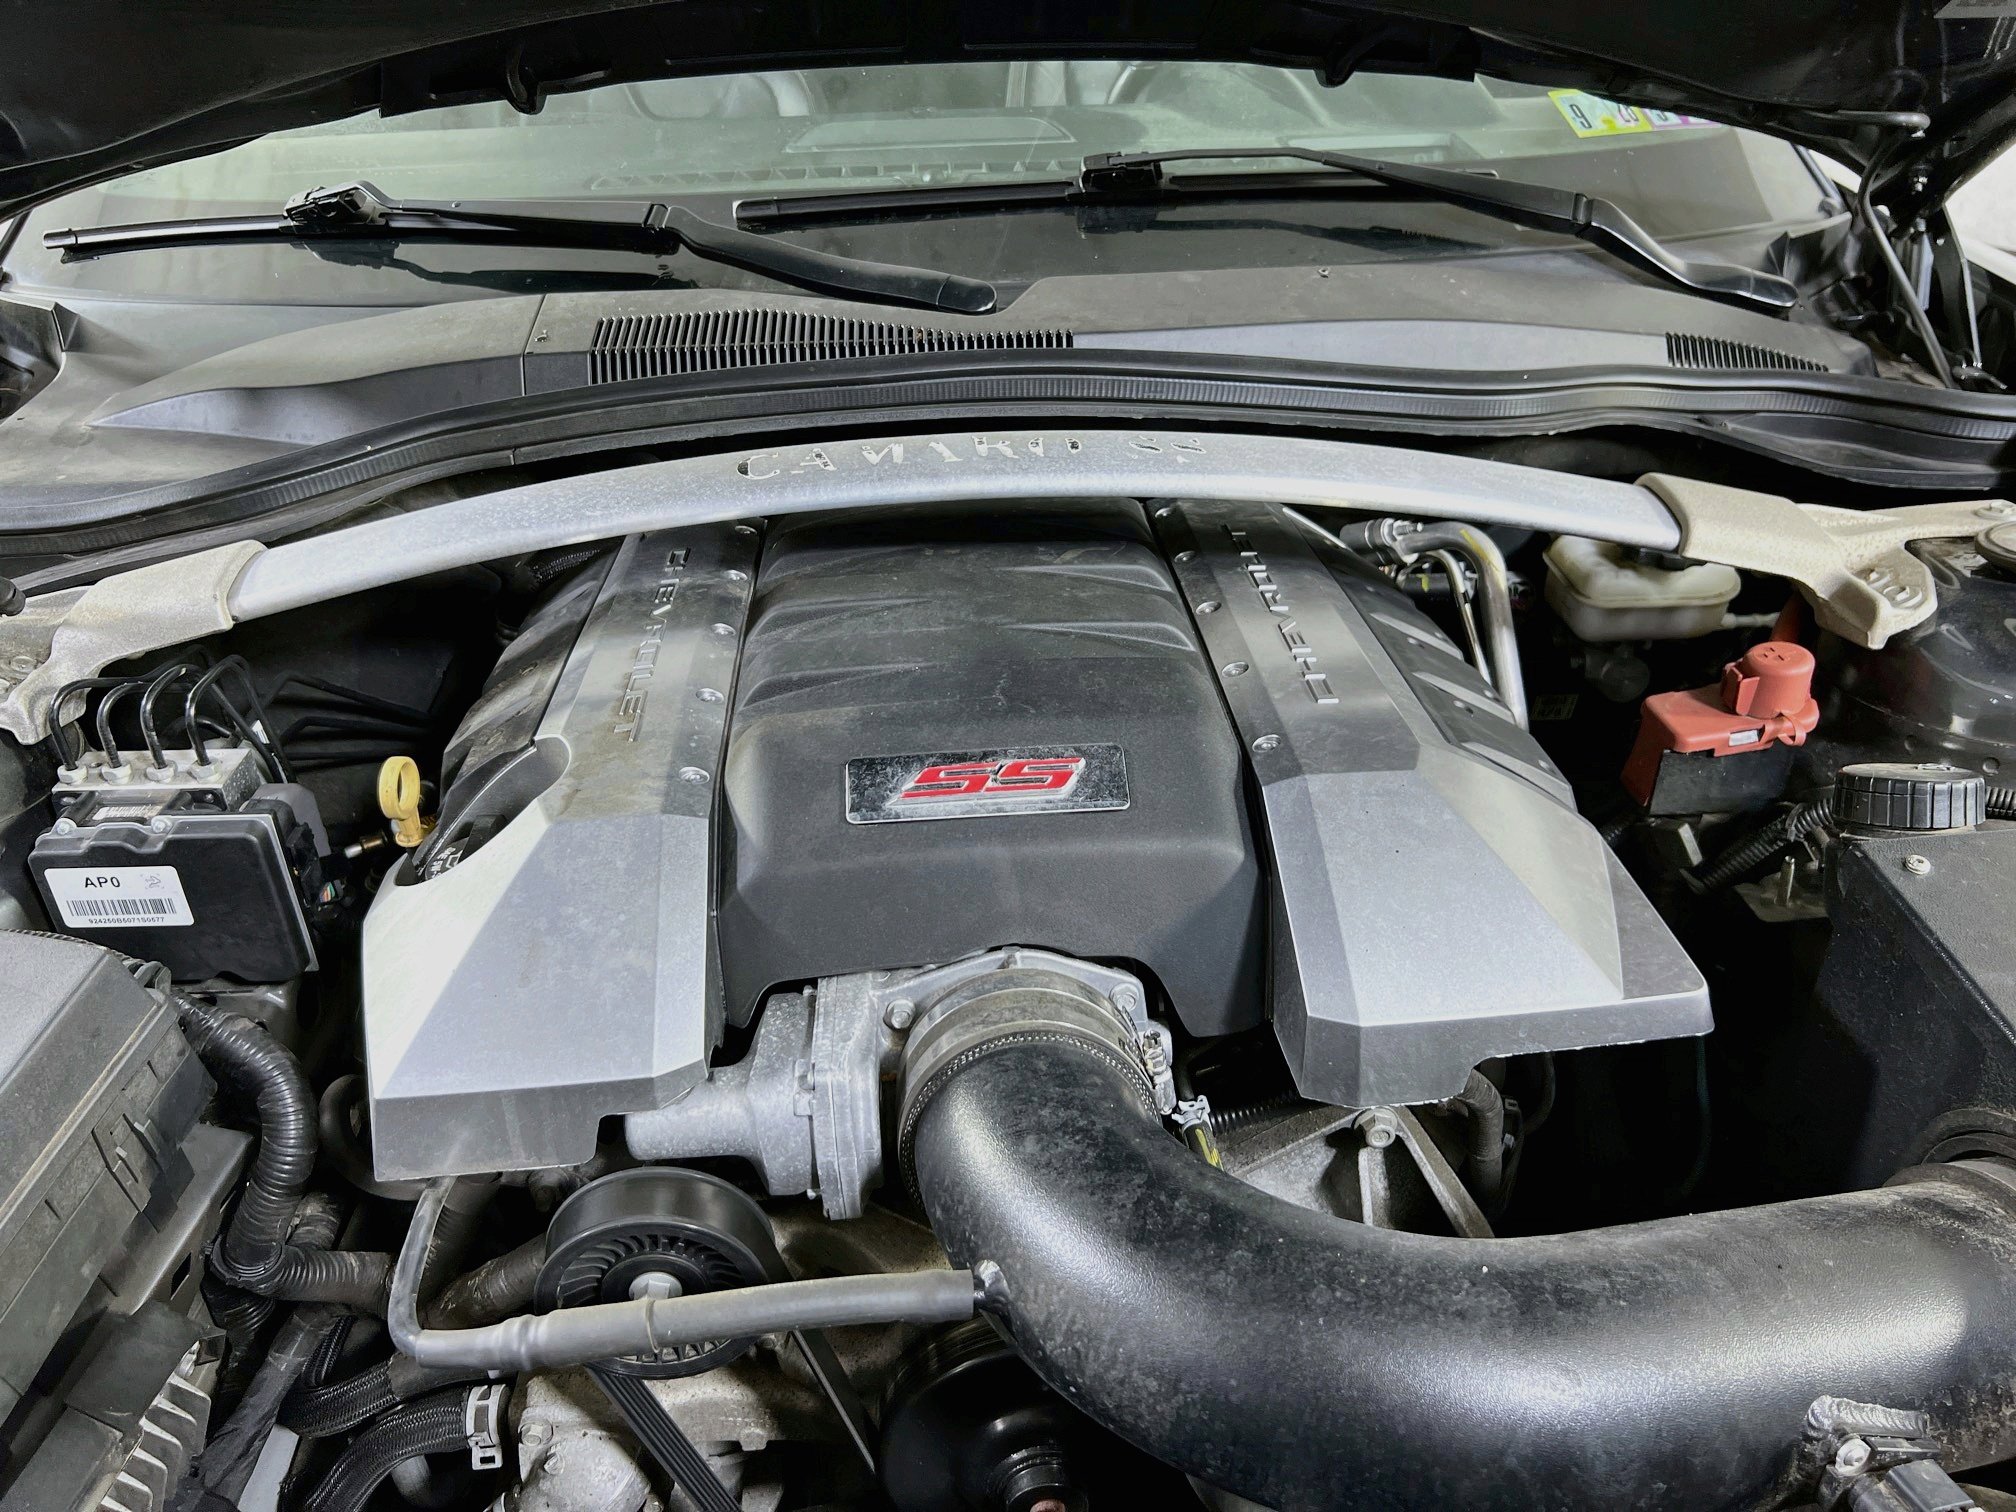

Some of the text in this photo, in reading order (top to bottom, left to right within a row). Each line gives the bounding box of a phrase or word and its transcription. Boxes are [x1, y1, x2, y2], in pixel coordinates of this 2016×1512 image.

[613, 546, 692, 742] CHEVROLET
[1219, 521, 1340, 704] CHEVROLET
[894, 756, 1086, 803] SS
